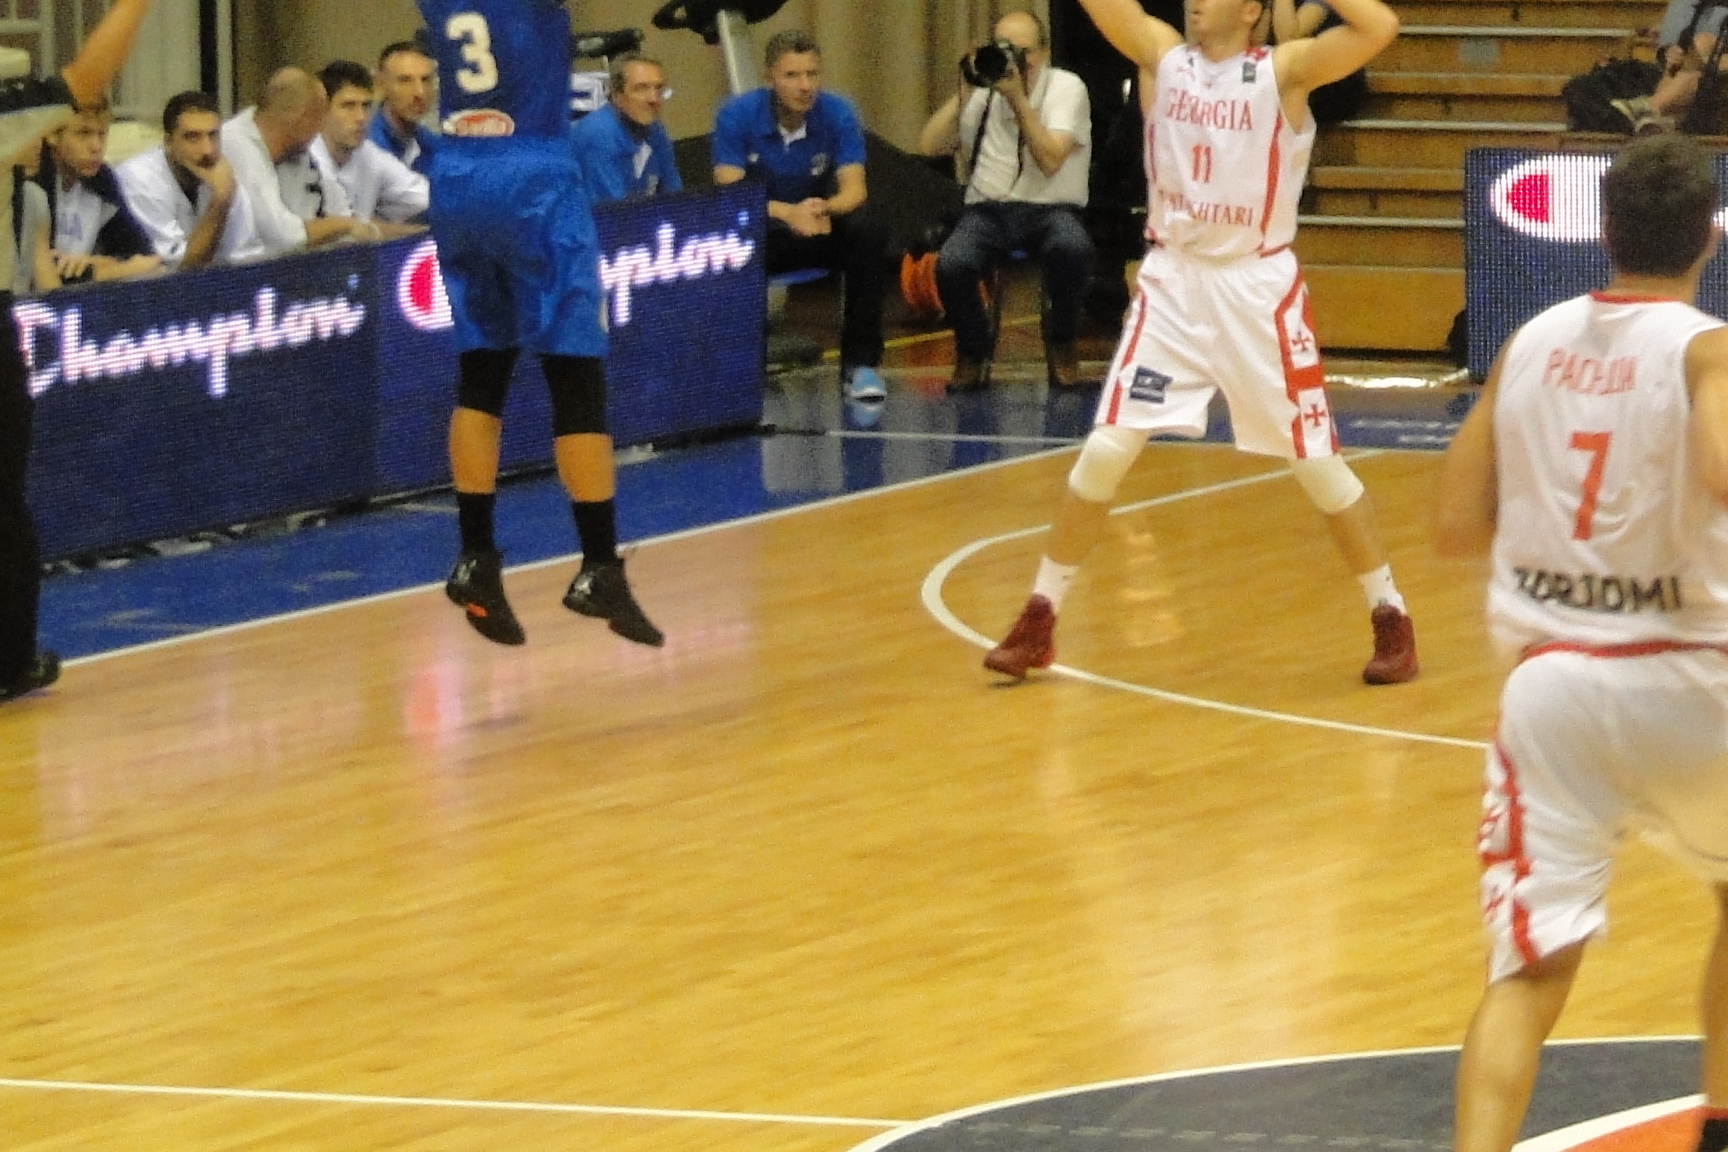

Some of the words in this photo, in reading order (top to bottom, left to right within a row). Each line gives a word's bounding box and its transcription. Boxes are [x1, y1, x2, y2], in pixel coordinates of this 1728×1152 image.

[446, 11, 499, 93] 3
[1192, 145, 1212, 184] 11
[1568, 430, 1613, 540] 7
